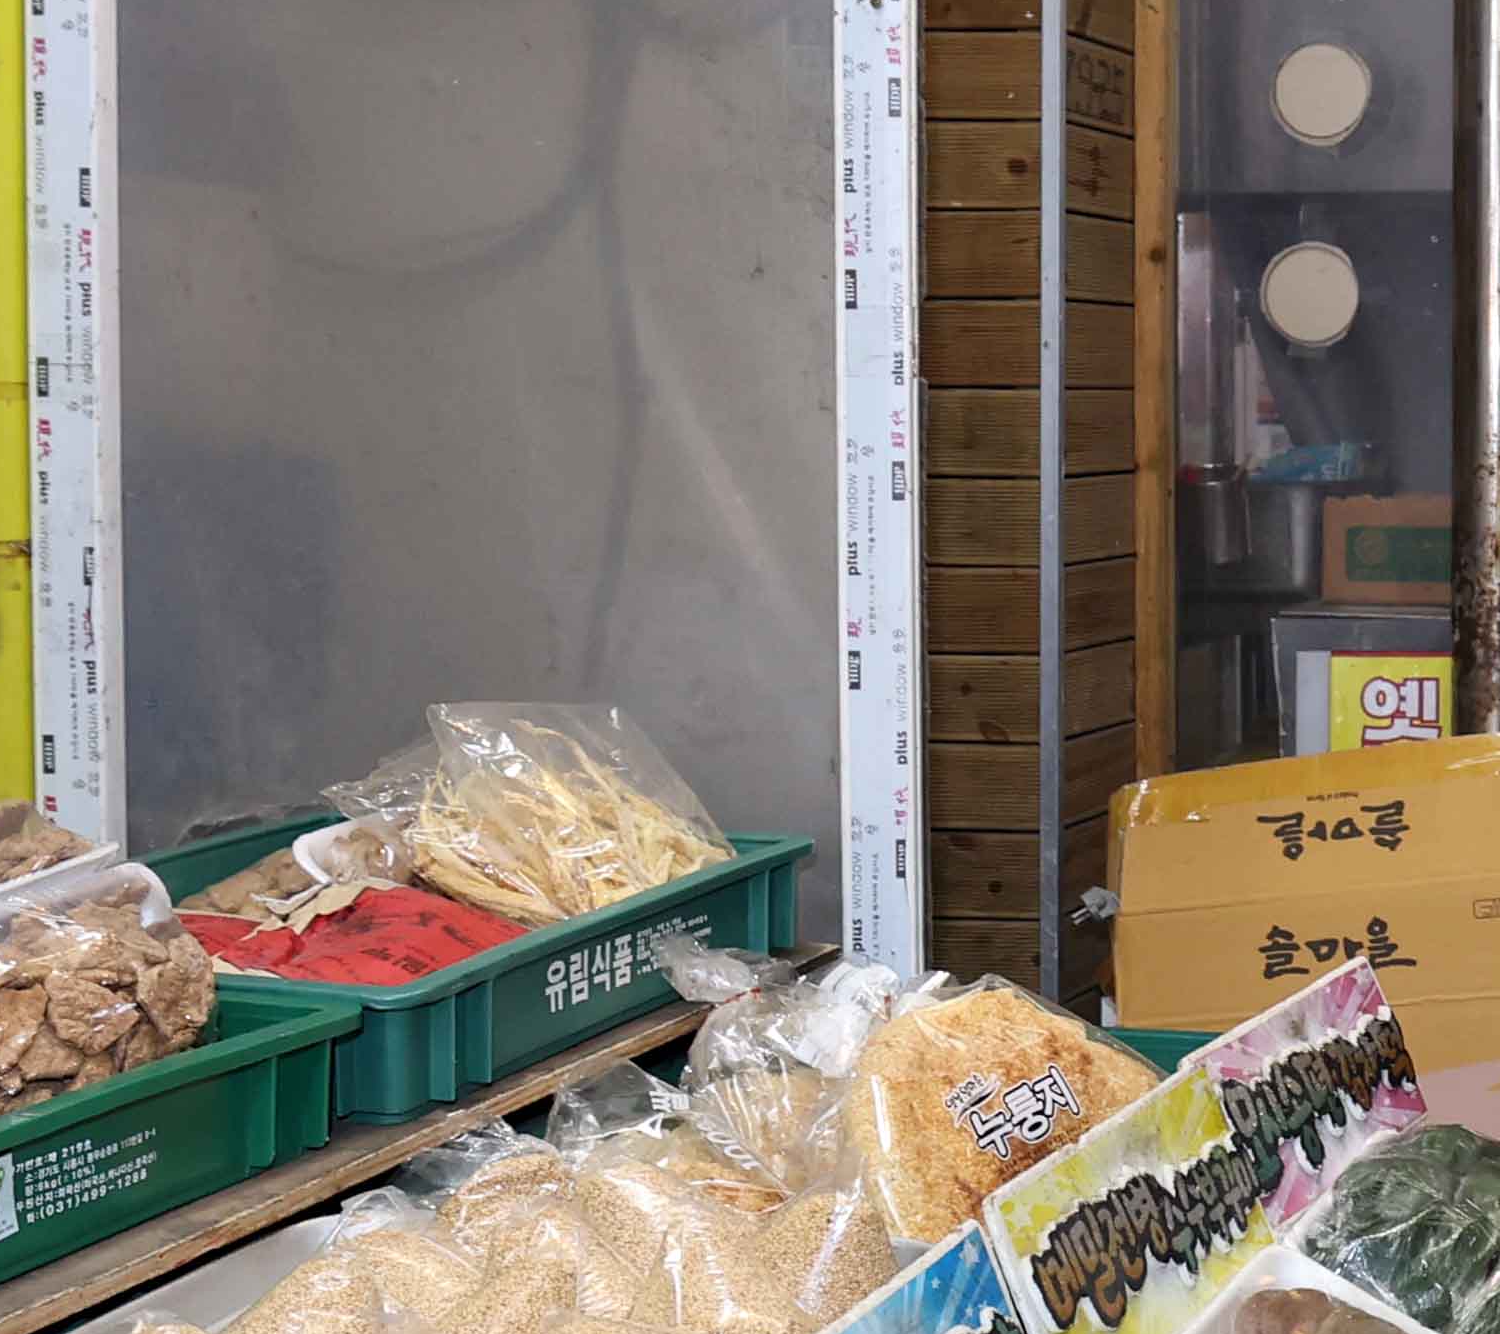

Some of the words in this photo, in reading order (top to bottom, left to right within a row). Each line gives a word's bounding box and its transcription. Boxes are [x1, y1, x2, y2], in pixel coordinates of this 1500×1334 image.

[1255, 798, 1411, 861] 솔마을
[544, 932, 634, 1014] 유림식품
[1257, 915, 1418, 981] 솔마을
[969, 1065, 1081, 1160] 누룽지
